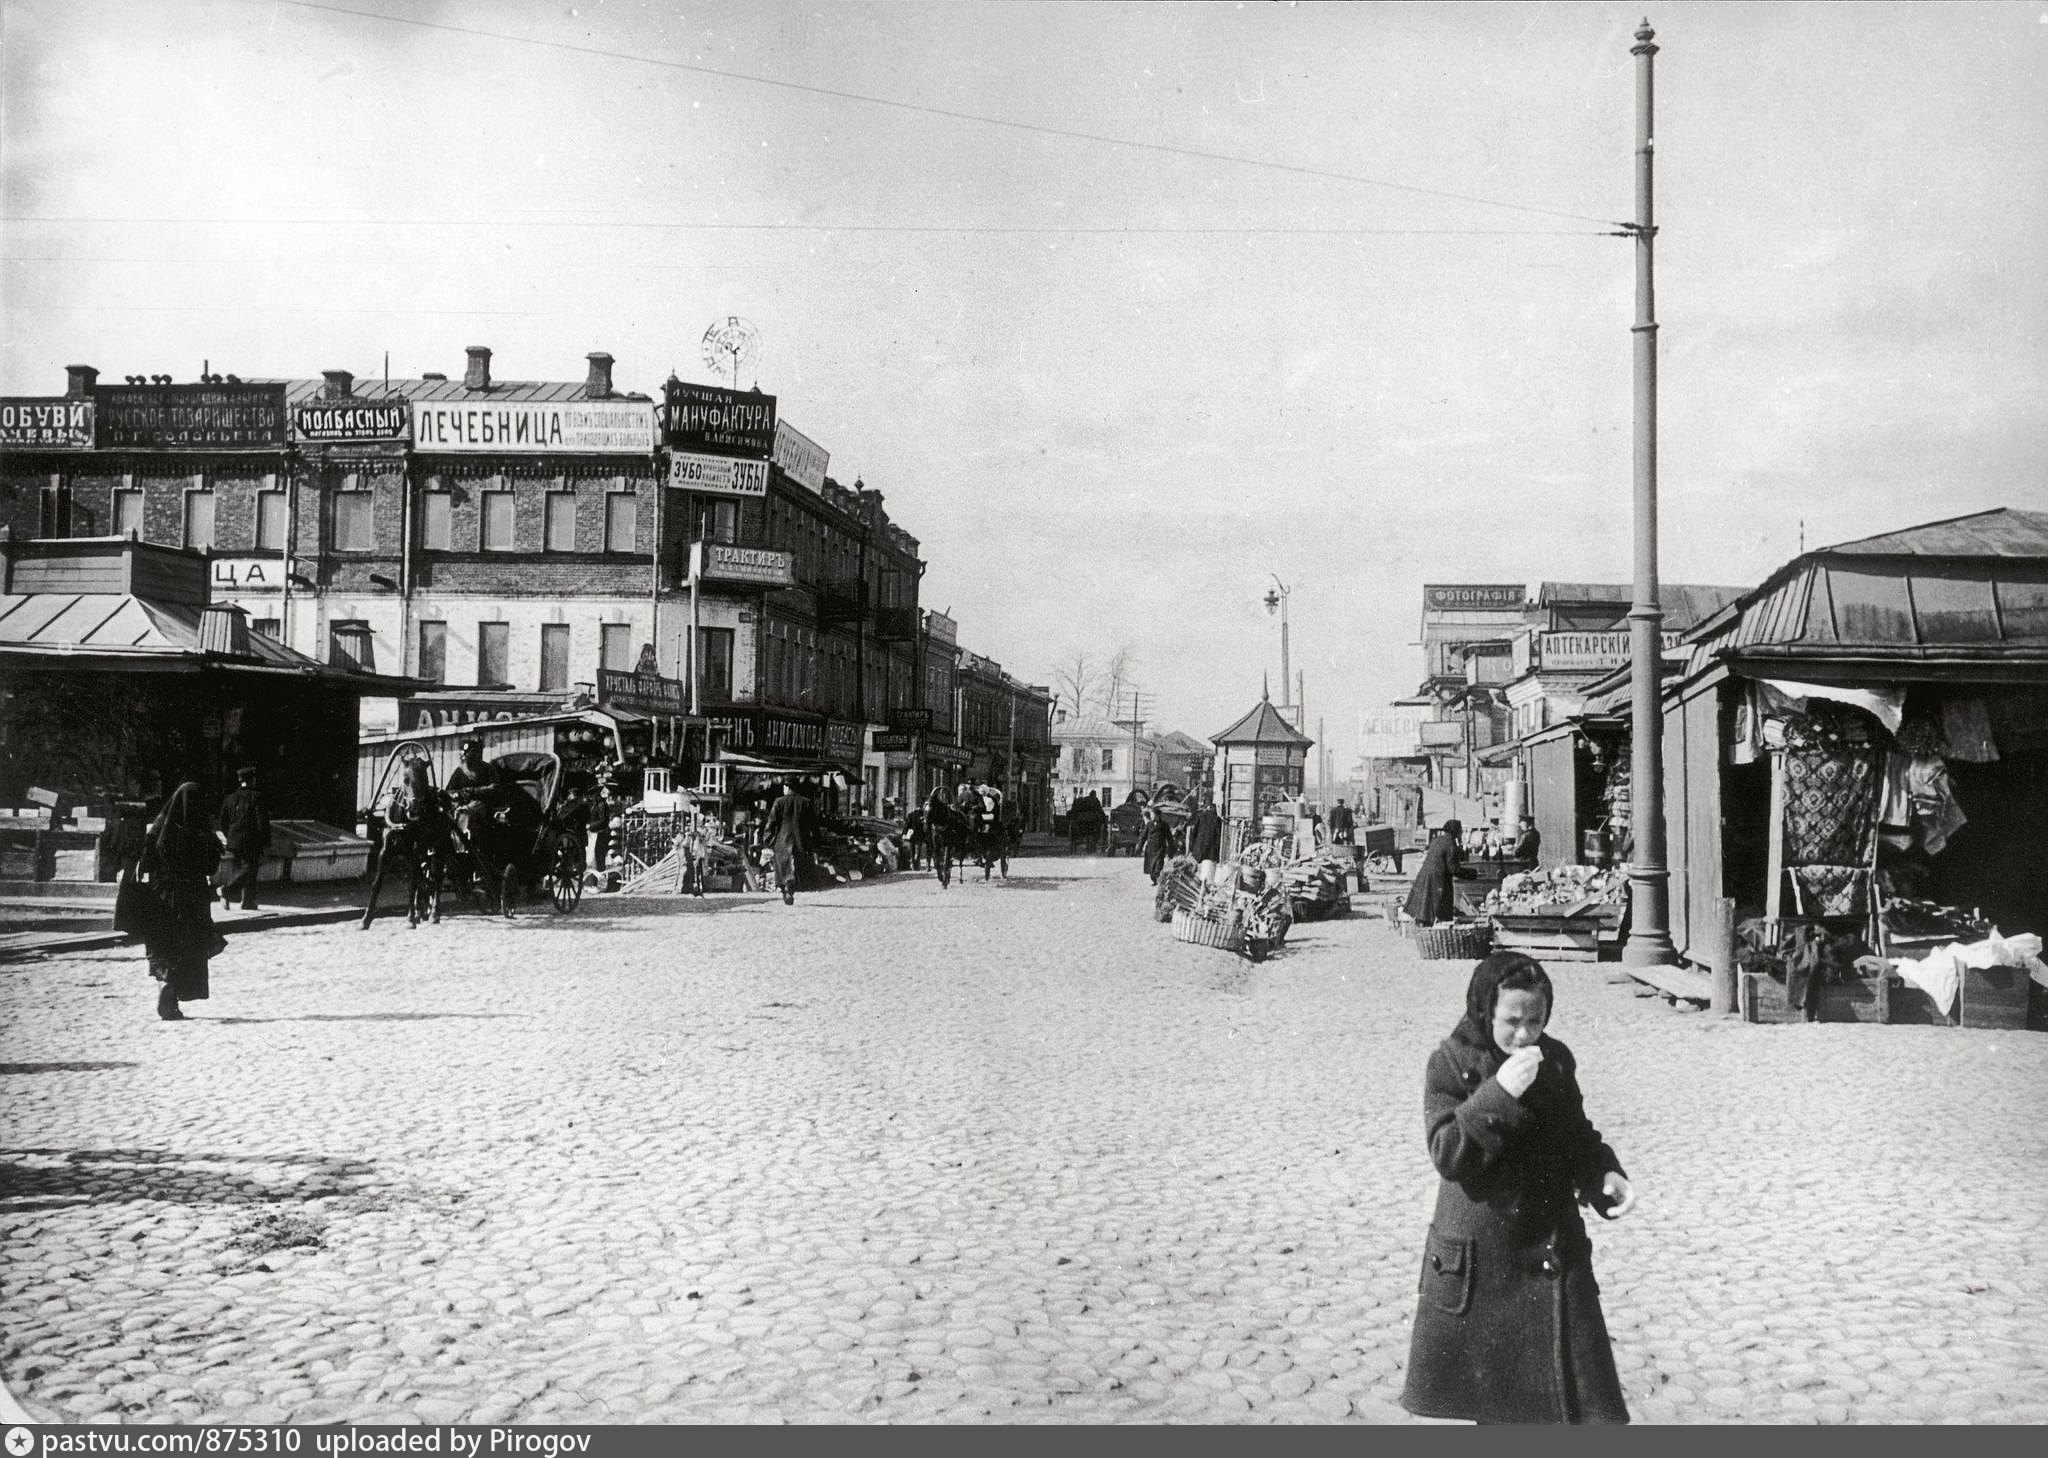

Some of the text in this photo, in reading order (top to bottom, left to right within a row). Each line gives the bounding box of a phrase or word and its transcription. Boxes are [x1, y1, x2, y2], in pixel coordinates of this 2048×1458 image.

[673, 388, 733, 404] ЛУЧШАЯ
[3, 406, 84, 428] ОБУВИ
[169, 407, 276, 428] ТОВАРИЩЕСТВО
[302, 407, 400, 430] КОЛБАСНЫЙ
[670, 404, 770, 431] МАНУФАКТУРА
[420, 411, 562, 446] ЛЕЧЕБНИЦА
[674, 461, 702, 480] ЗУБО
[731, 461, 765, 492] ЗУБЫ
[716, 547, 785, 568] ТРАКТИРЪ
[1435, 590, 1515, 601] ФОТОГРАФІЯ
[1545, 633, 1631, 654] АПТЕКАРСКІЙ
[766, 720, 823, 750] АНИСИМОВА
